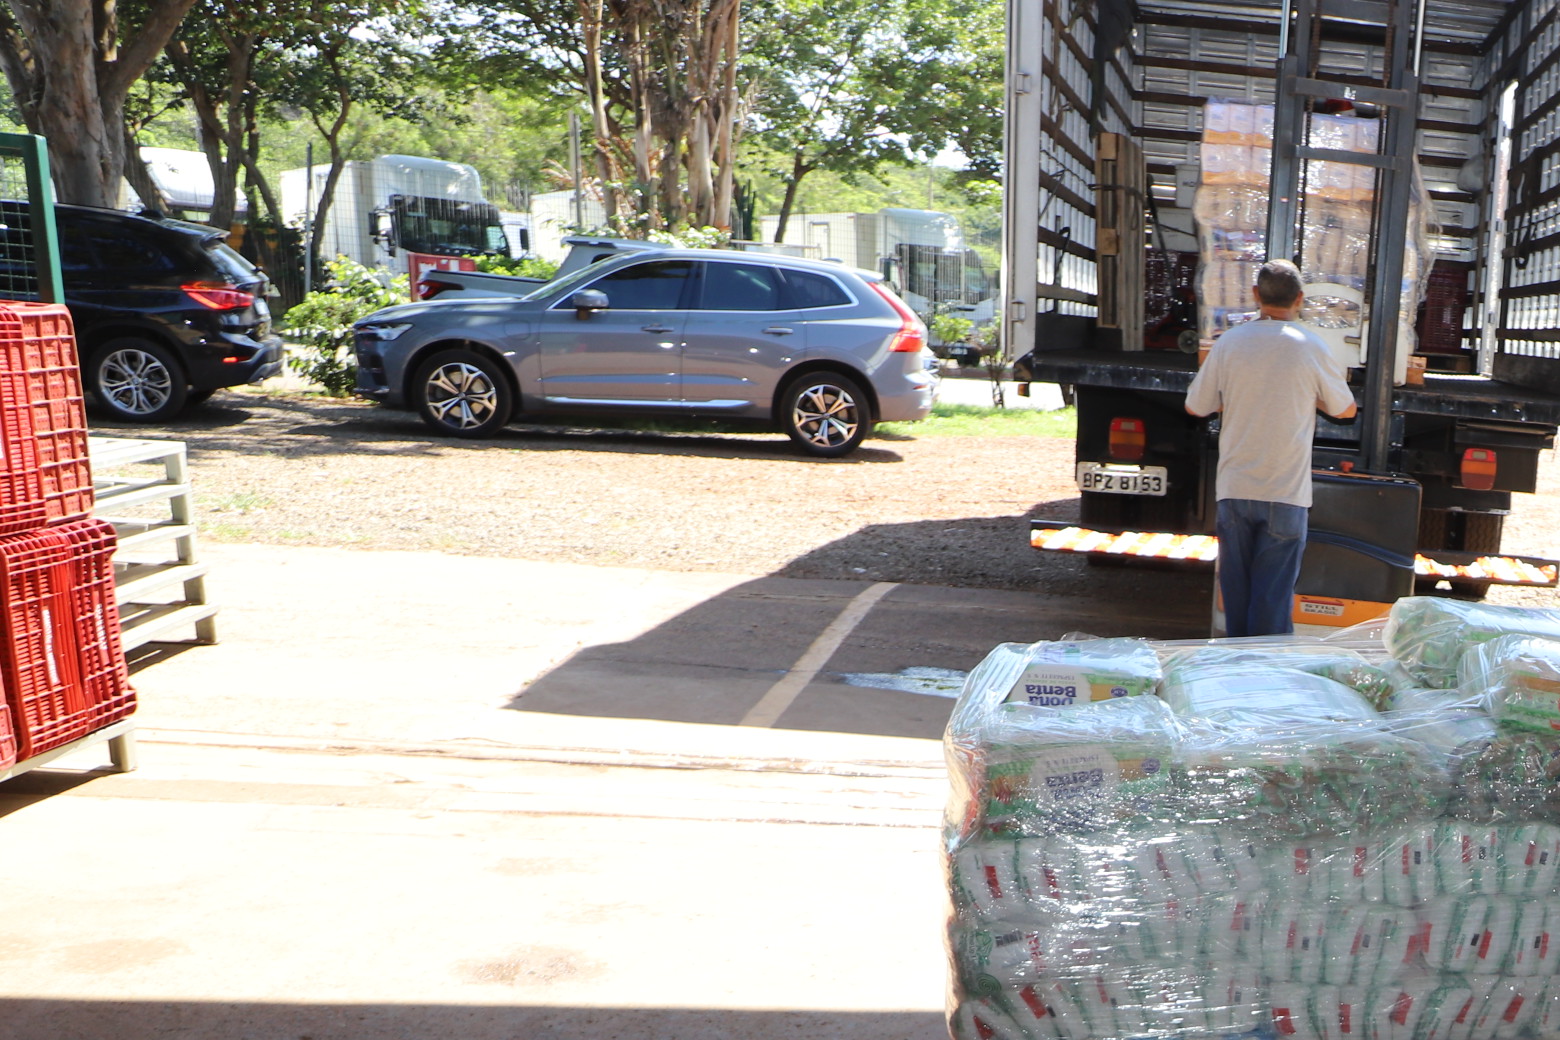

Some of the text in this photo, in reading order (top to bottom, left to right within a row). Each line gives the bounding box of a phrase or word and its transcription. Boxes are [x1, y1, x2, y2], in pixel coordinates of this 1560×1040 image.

[1083, 472, 1162, 492] BPZ 8153
[1025, 684, 1077, 697] Benta
